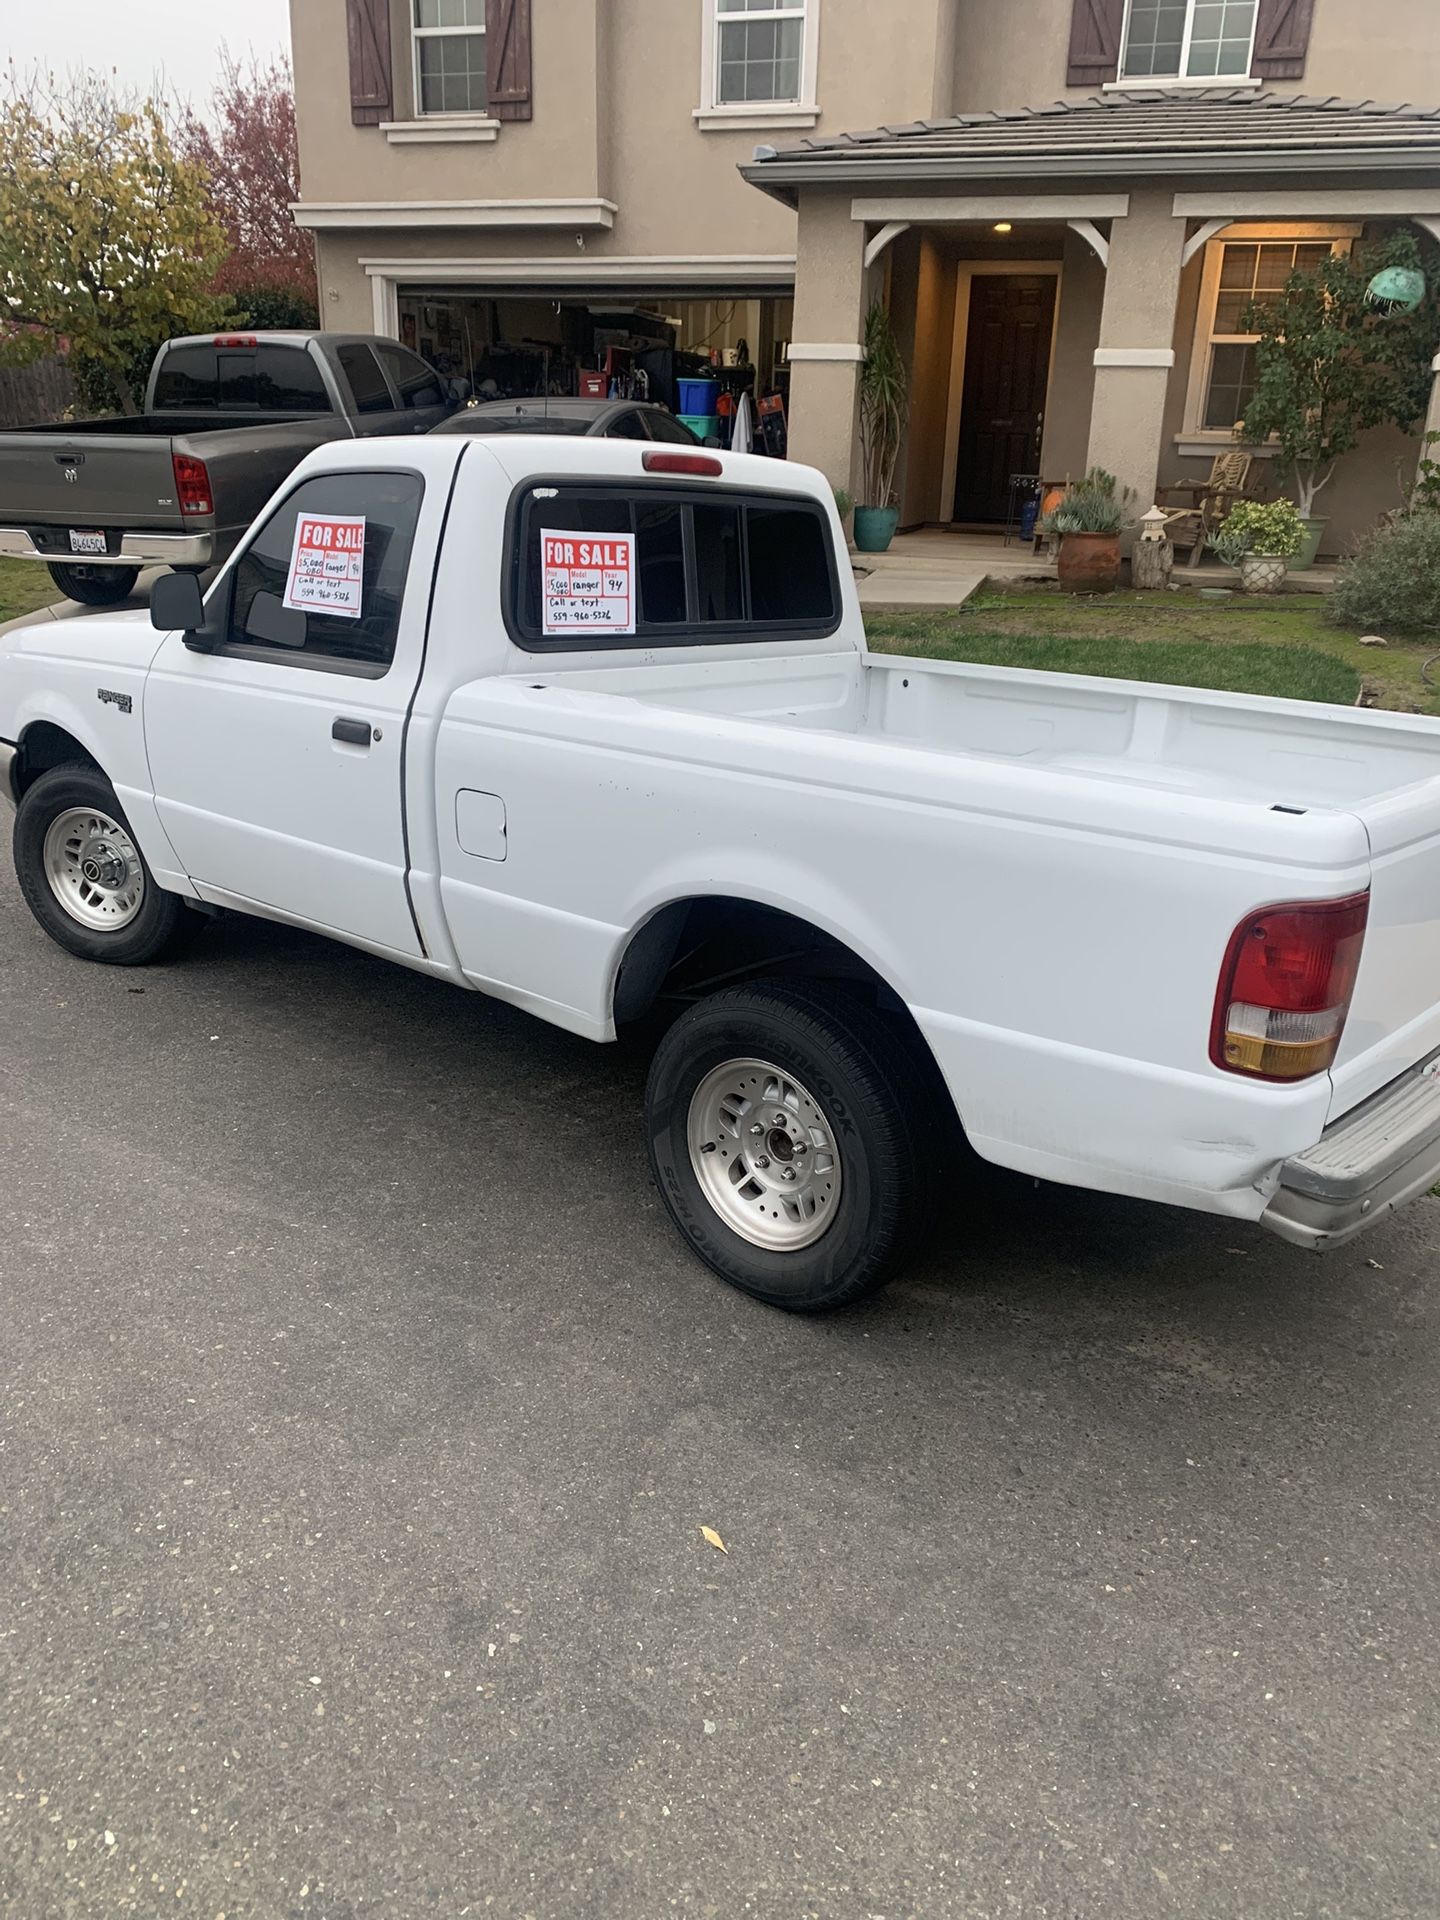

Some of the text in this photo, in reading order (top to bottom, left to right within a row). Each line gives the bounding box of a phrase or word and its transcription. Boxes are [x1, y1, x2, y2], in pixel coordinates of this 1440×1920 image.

[302, 524, 363, 549] FOR SALE
[546, 541, 627, 566] FOR SALE
[298, 576, 315, 584] Call
[571, 570, 587, 578] Model
[572, 580, 600, 592] ranger
[608, 579, 623, 591] 94
[549, 597, 566, 608] Call
